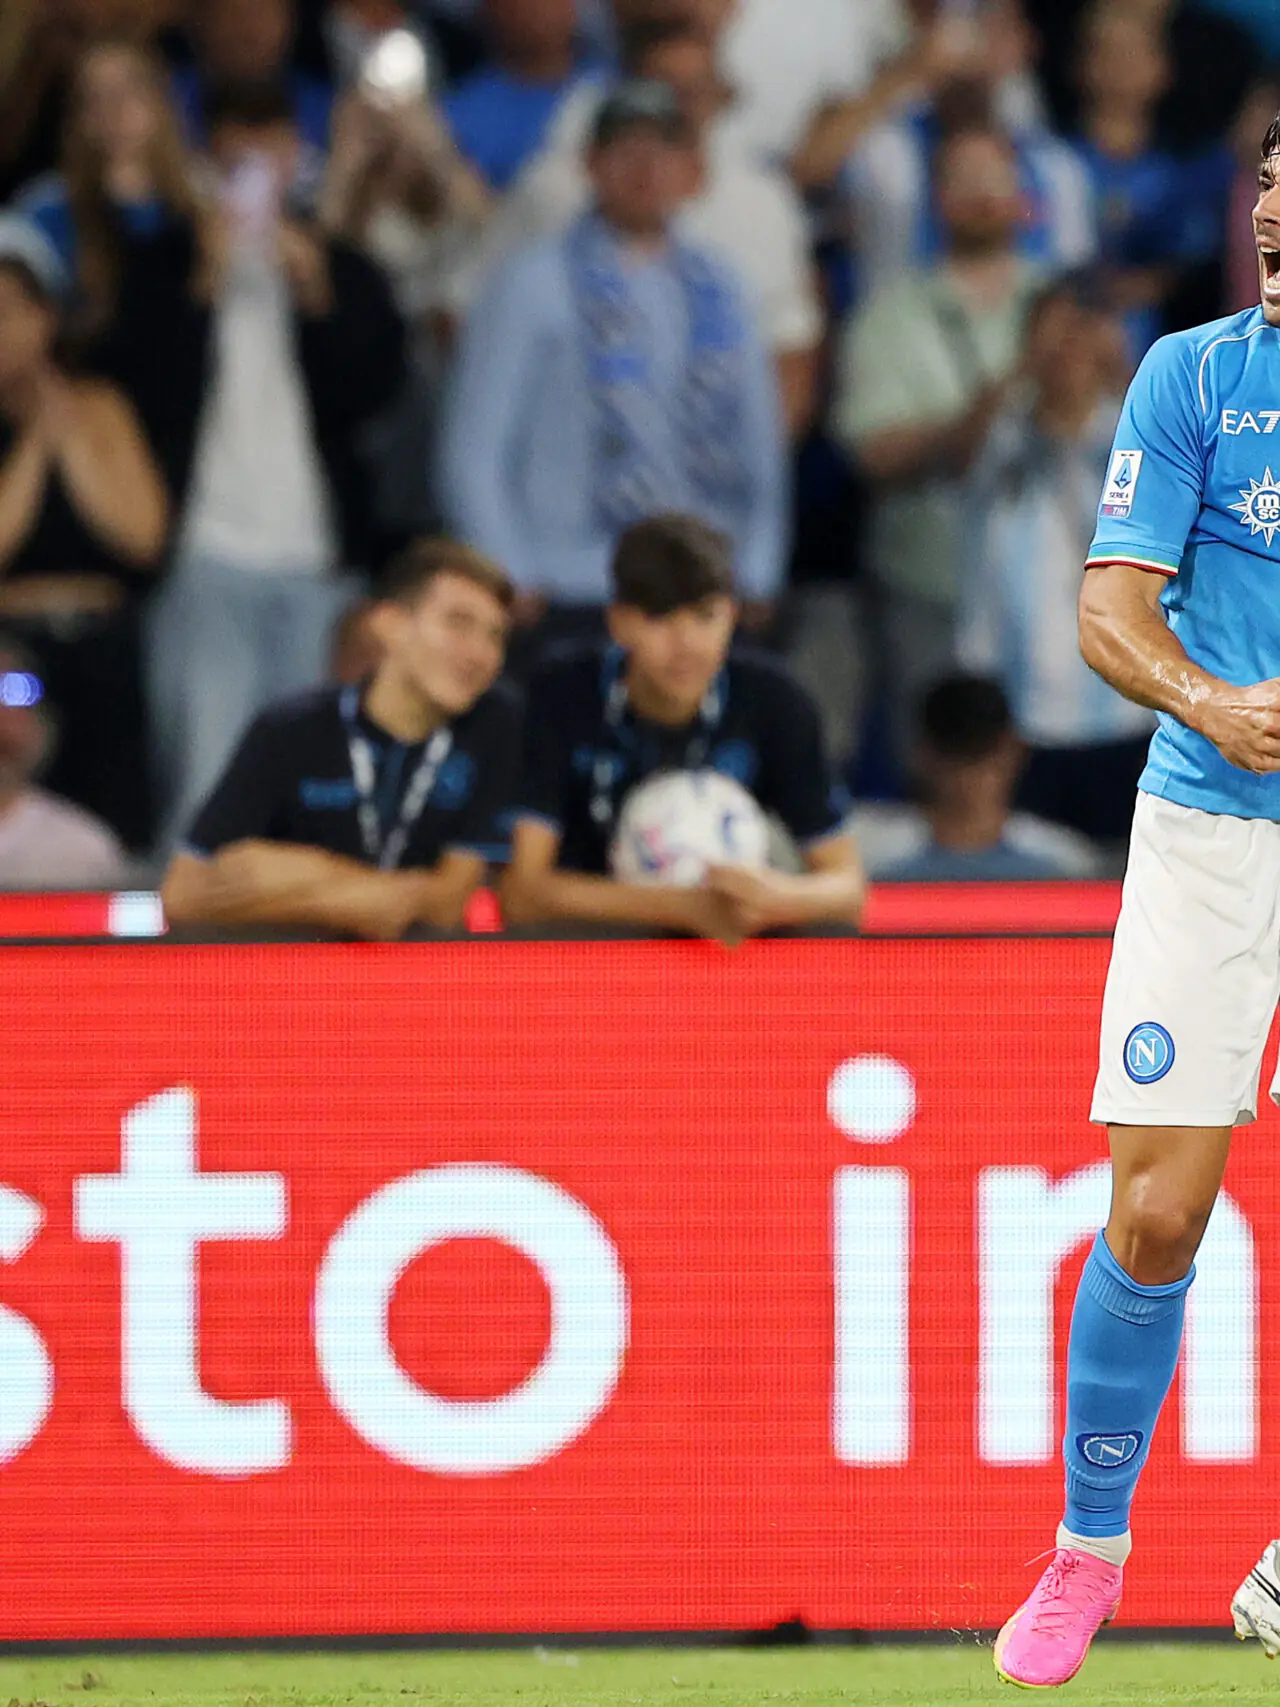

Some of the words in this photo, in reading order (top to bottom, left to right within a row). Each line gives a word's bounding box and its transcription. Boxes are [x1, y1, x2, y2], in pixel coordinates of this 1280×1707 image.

[1109, 491, 1125, 499] SERIE
[1111, 506, 1128, 517] TIM
[1134, 1037, 1159, 1067] N
[0, 1086, 630, 1477] to
[1096, 1440, 1126, 1460] N
